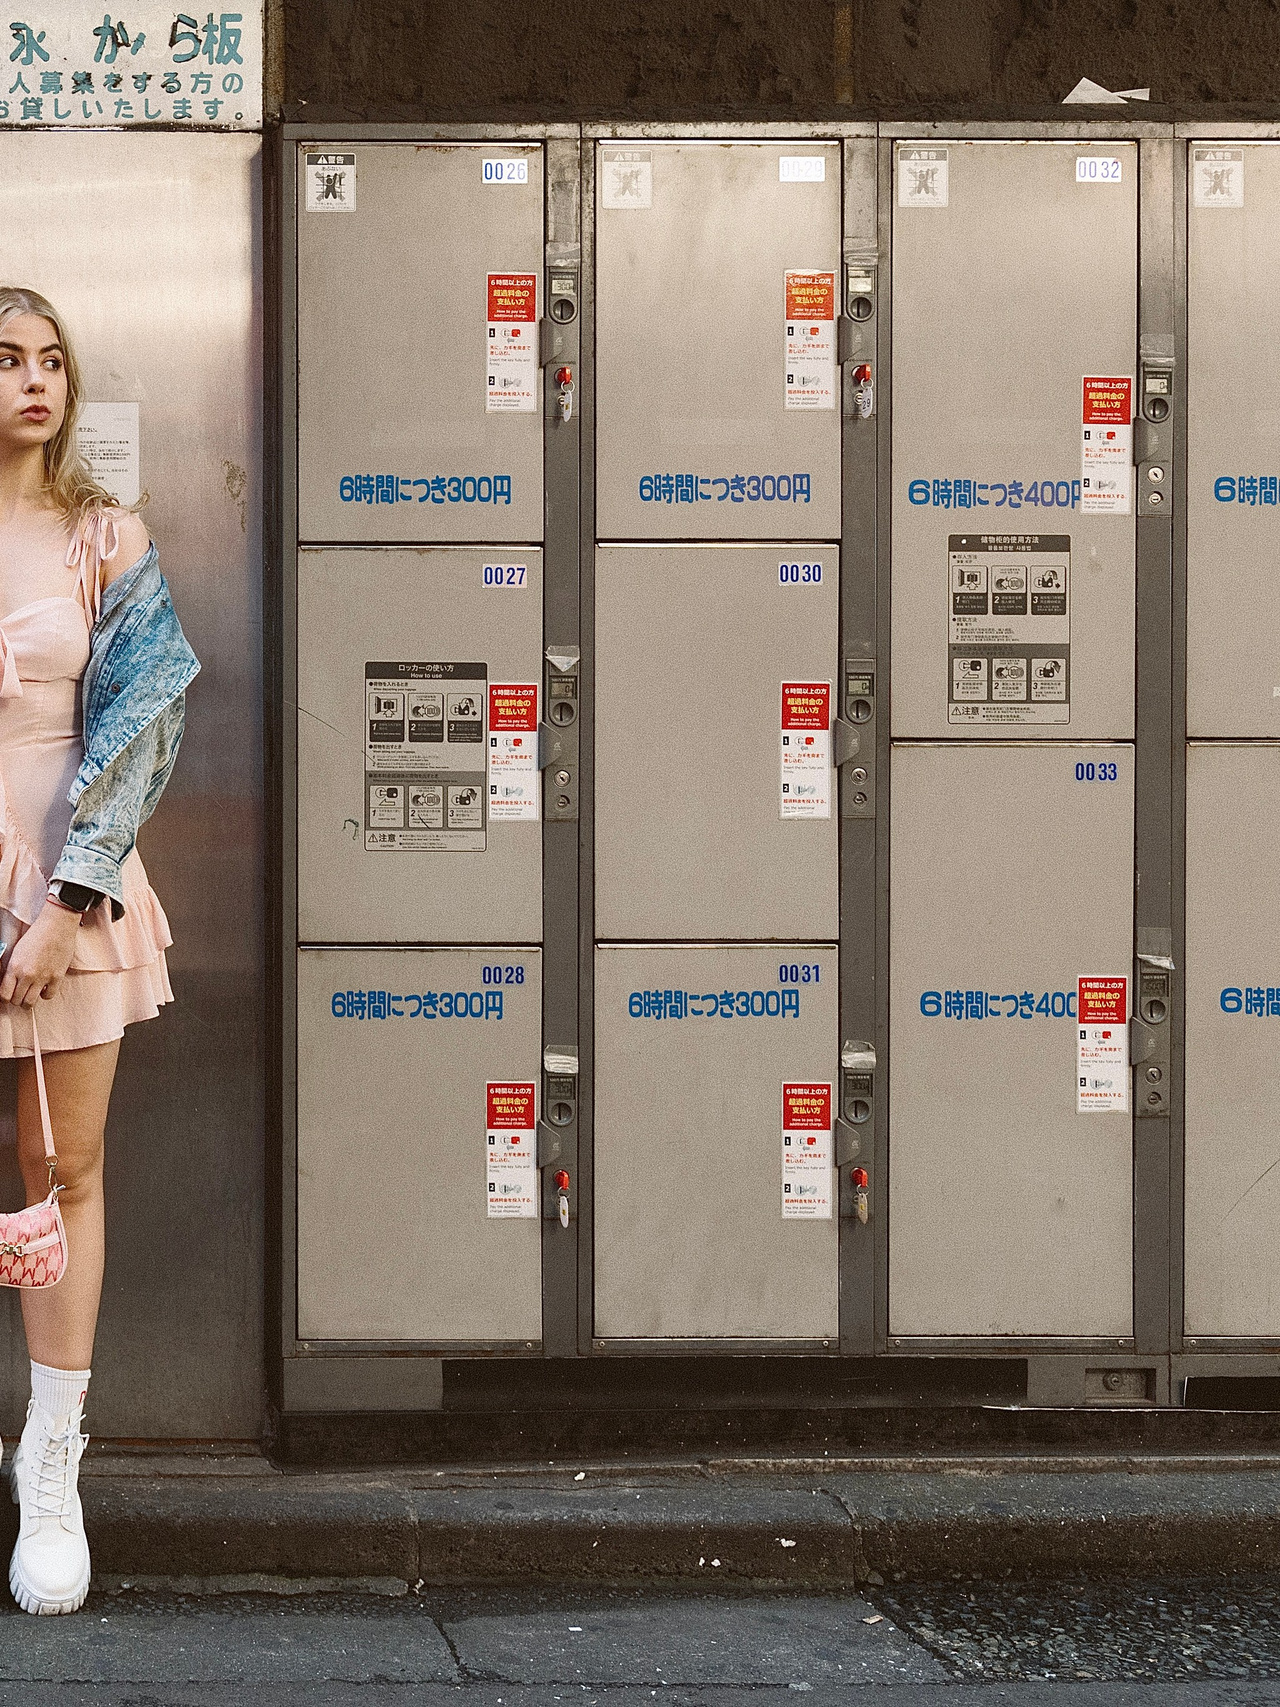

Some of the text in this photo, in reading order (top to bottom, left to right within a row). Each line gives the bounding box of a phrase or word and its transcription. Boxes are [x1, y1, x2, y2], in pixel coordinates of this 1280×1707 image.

[484, 162, 527, 181] 0026
[1078, 160, 1120, 179] 0032
[339, 474, 513, 506] 6時間につき300円
[639, 473, 812, 505] 6時間につき300円
[1213, 475, 1280, 506] 6時間
[484, 566, 526, 585] 0027
[779, 564, 822, 583] 0030
[398, 664, 454, 673] ロッカーの使い方
[961, 706, 980, 716] 注意
[1075, 762, 1118, 781] 0033
[378, 833, 396, 843] 注意
[482, 966, 525, 985] 0028
[779, 964, 820, 983] 0031
[331, 991, 504, 1022] 6時間につき300円
[628, 990, 801, 1021] 6時間につき300円
